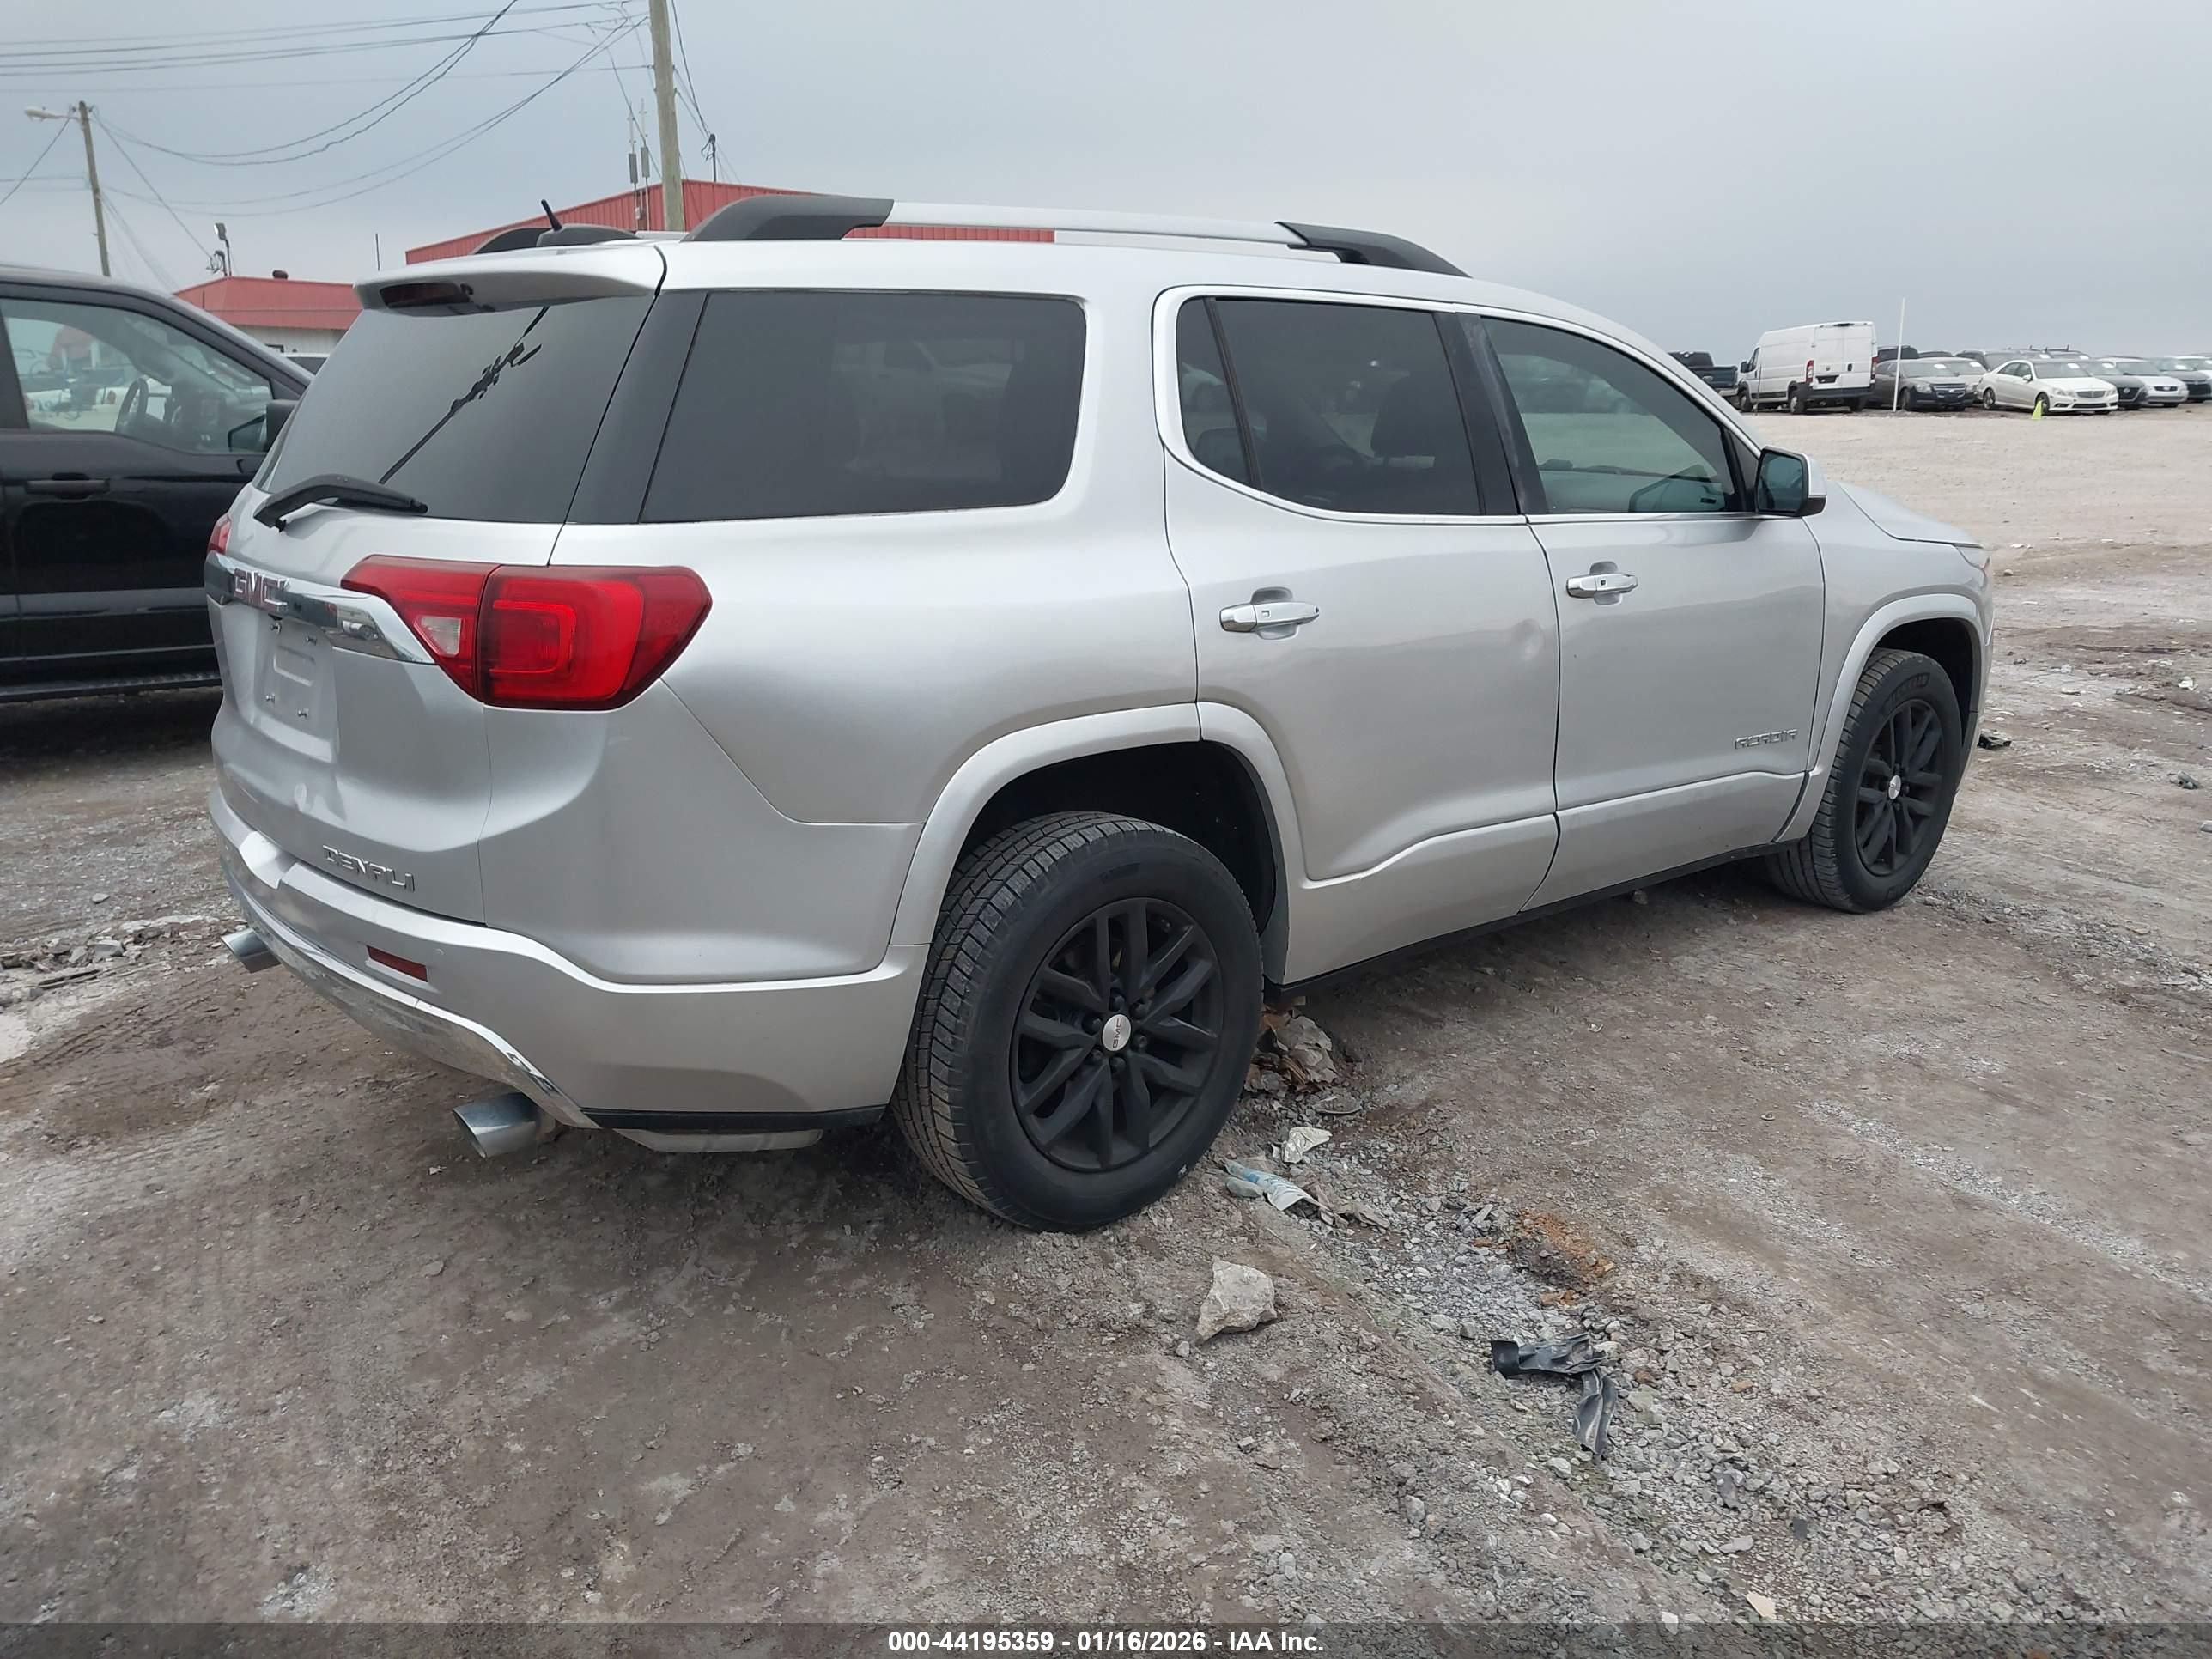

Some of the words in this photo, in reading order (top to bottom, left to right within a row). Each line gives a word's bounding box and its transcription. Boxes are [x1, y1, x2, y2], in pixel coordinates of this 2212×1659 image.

[233, 567, 289, 611] GMC
[322, 844, 416, 893] DENALI
[1112, 1018, 1122, 1048] GMC
